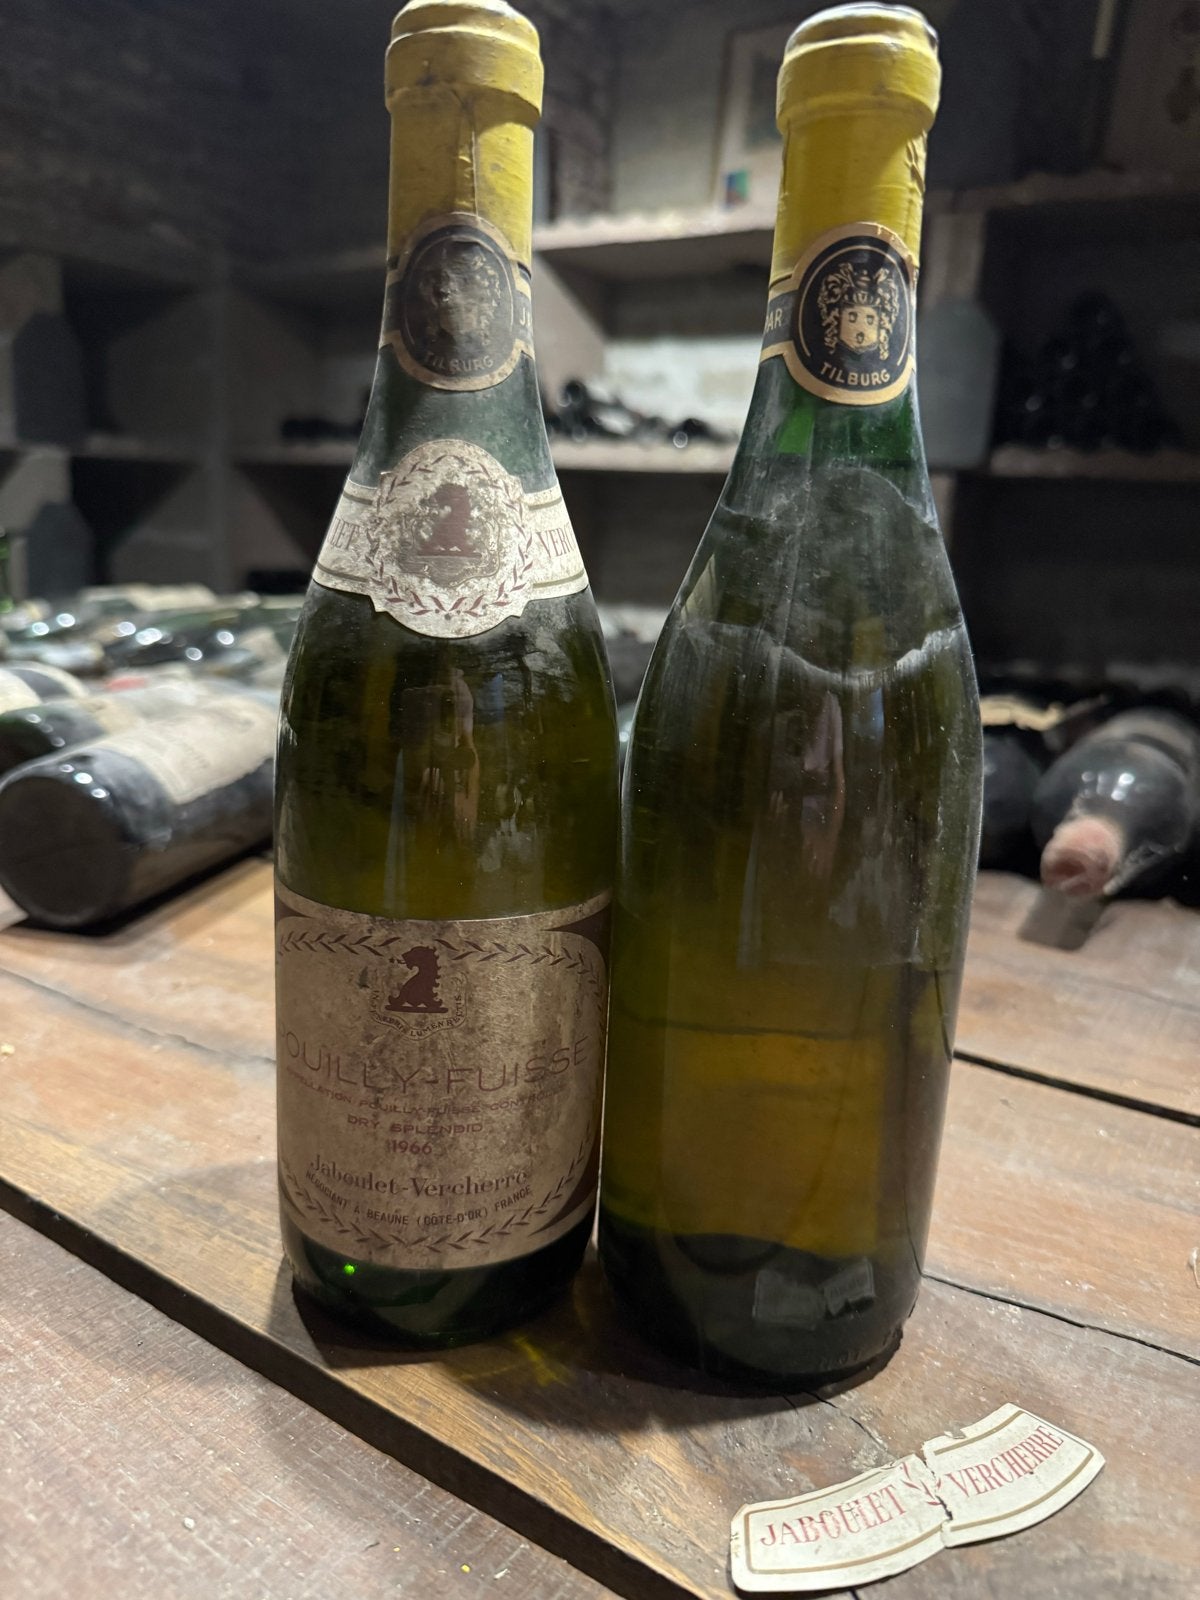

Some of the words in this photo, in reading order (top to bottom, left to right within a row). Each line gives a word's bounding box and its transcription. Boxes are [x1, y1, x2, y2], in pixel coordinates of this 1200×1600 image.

[424, 351, 494, 373] TILBURG
[820, 362, 891, 386] TILBURG
[347, 1114, 380, 1131] DRY
[389, 1123, 484, 1135] SPLENDID
[392, 1140, 432, 1155] 1966
[310, 1153, 528, 1198] Jaboulet-Vercherre
[367, 1209, 409, 1226] BEAUNE
[494, 1183, 532, 1212] FRANCE
[759, 1484, 907, 1547] JABOULET
[946, 1425, 1065, 1498] VERCHERRE
